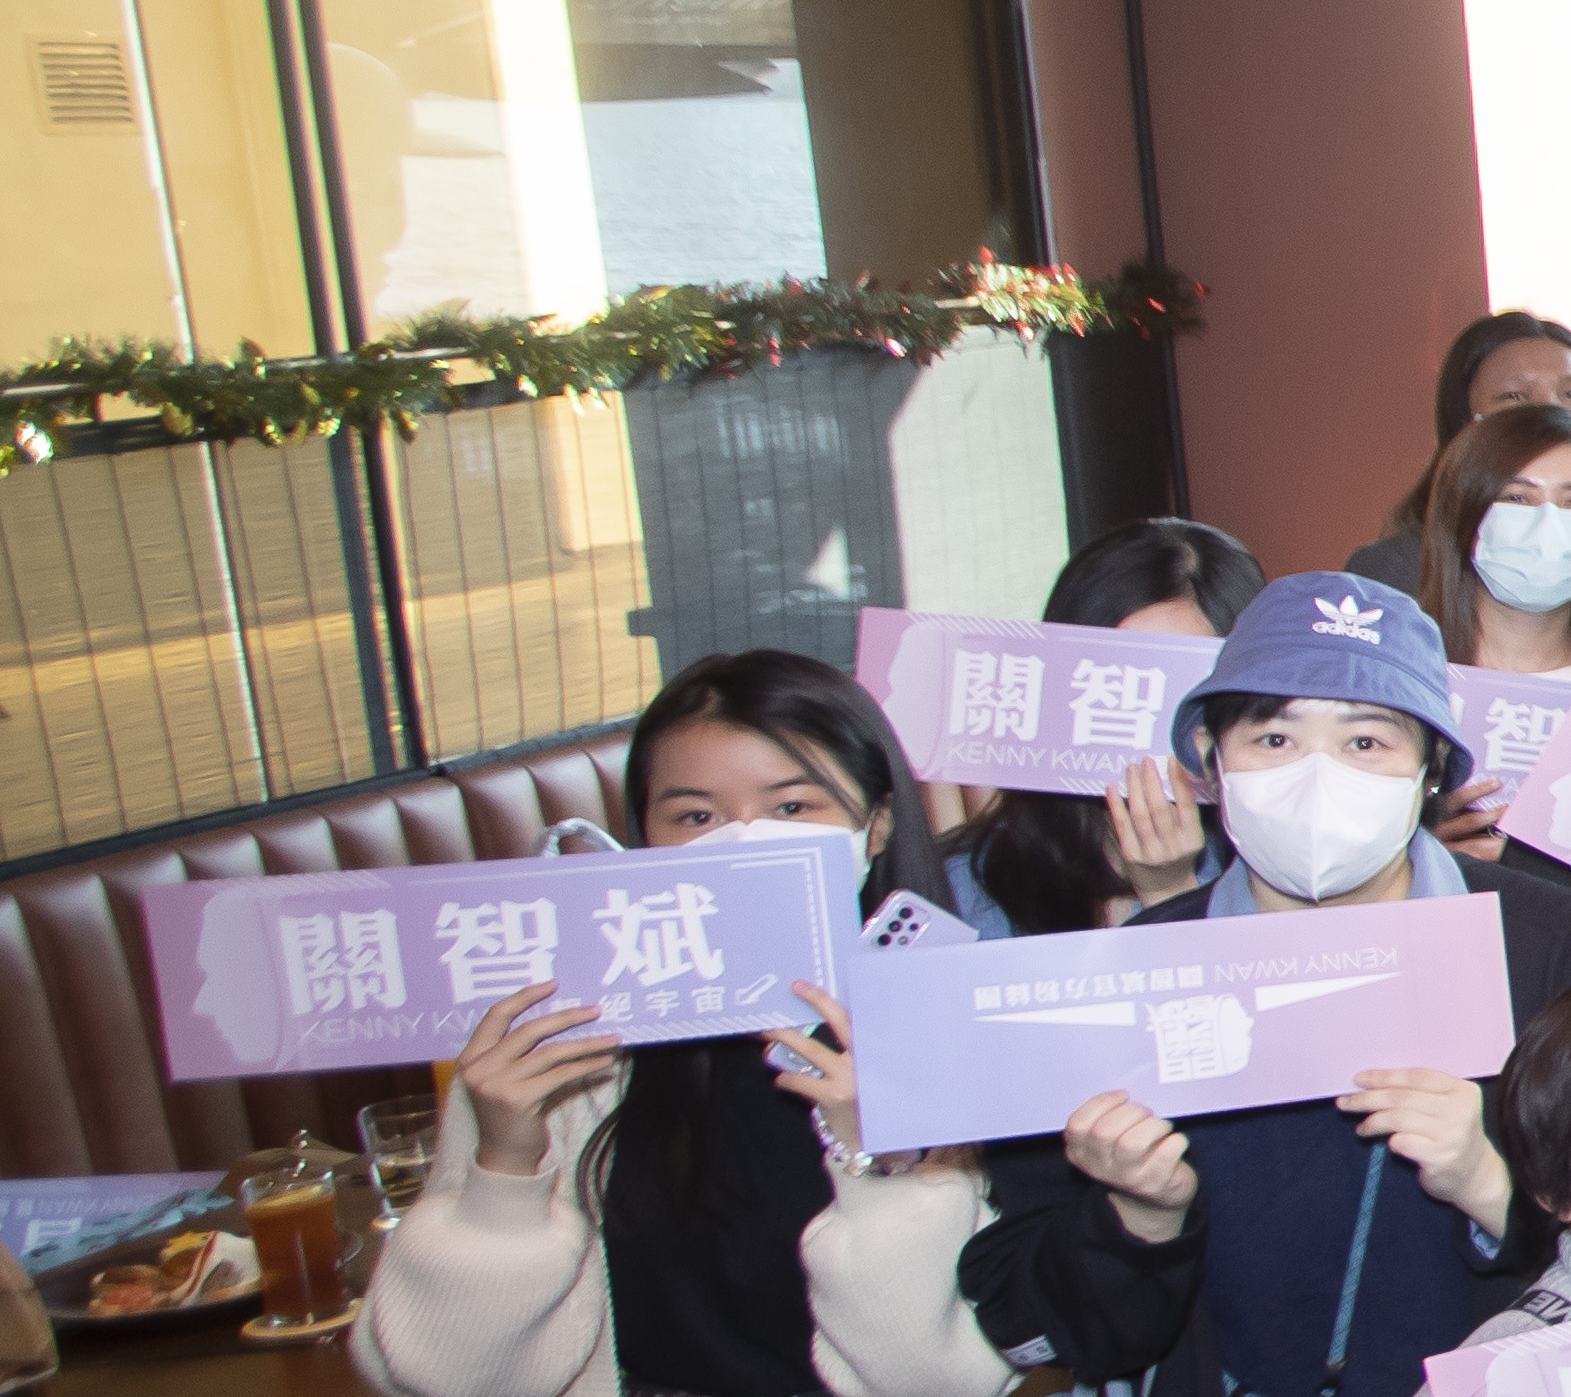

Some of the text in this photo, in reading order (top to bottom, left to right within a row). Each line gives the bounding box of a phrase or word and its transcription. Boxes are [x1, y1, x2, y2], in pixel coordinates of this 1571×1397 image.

[1312, 621, 1381, 645] adidas
[946, 741, 1050, 769] KENNY
[277, 882, 726, 1016] 關智斌
[1304, 946, 1398, 974] KENNY
[1215, 957, 1298, 985] KWAN
[300, 1009, 426, 1046] KENNY
